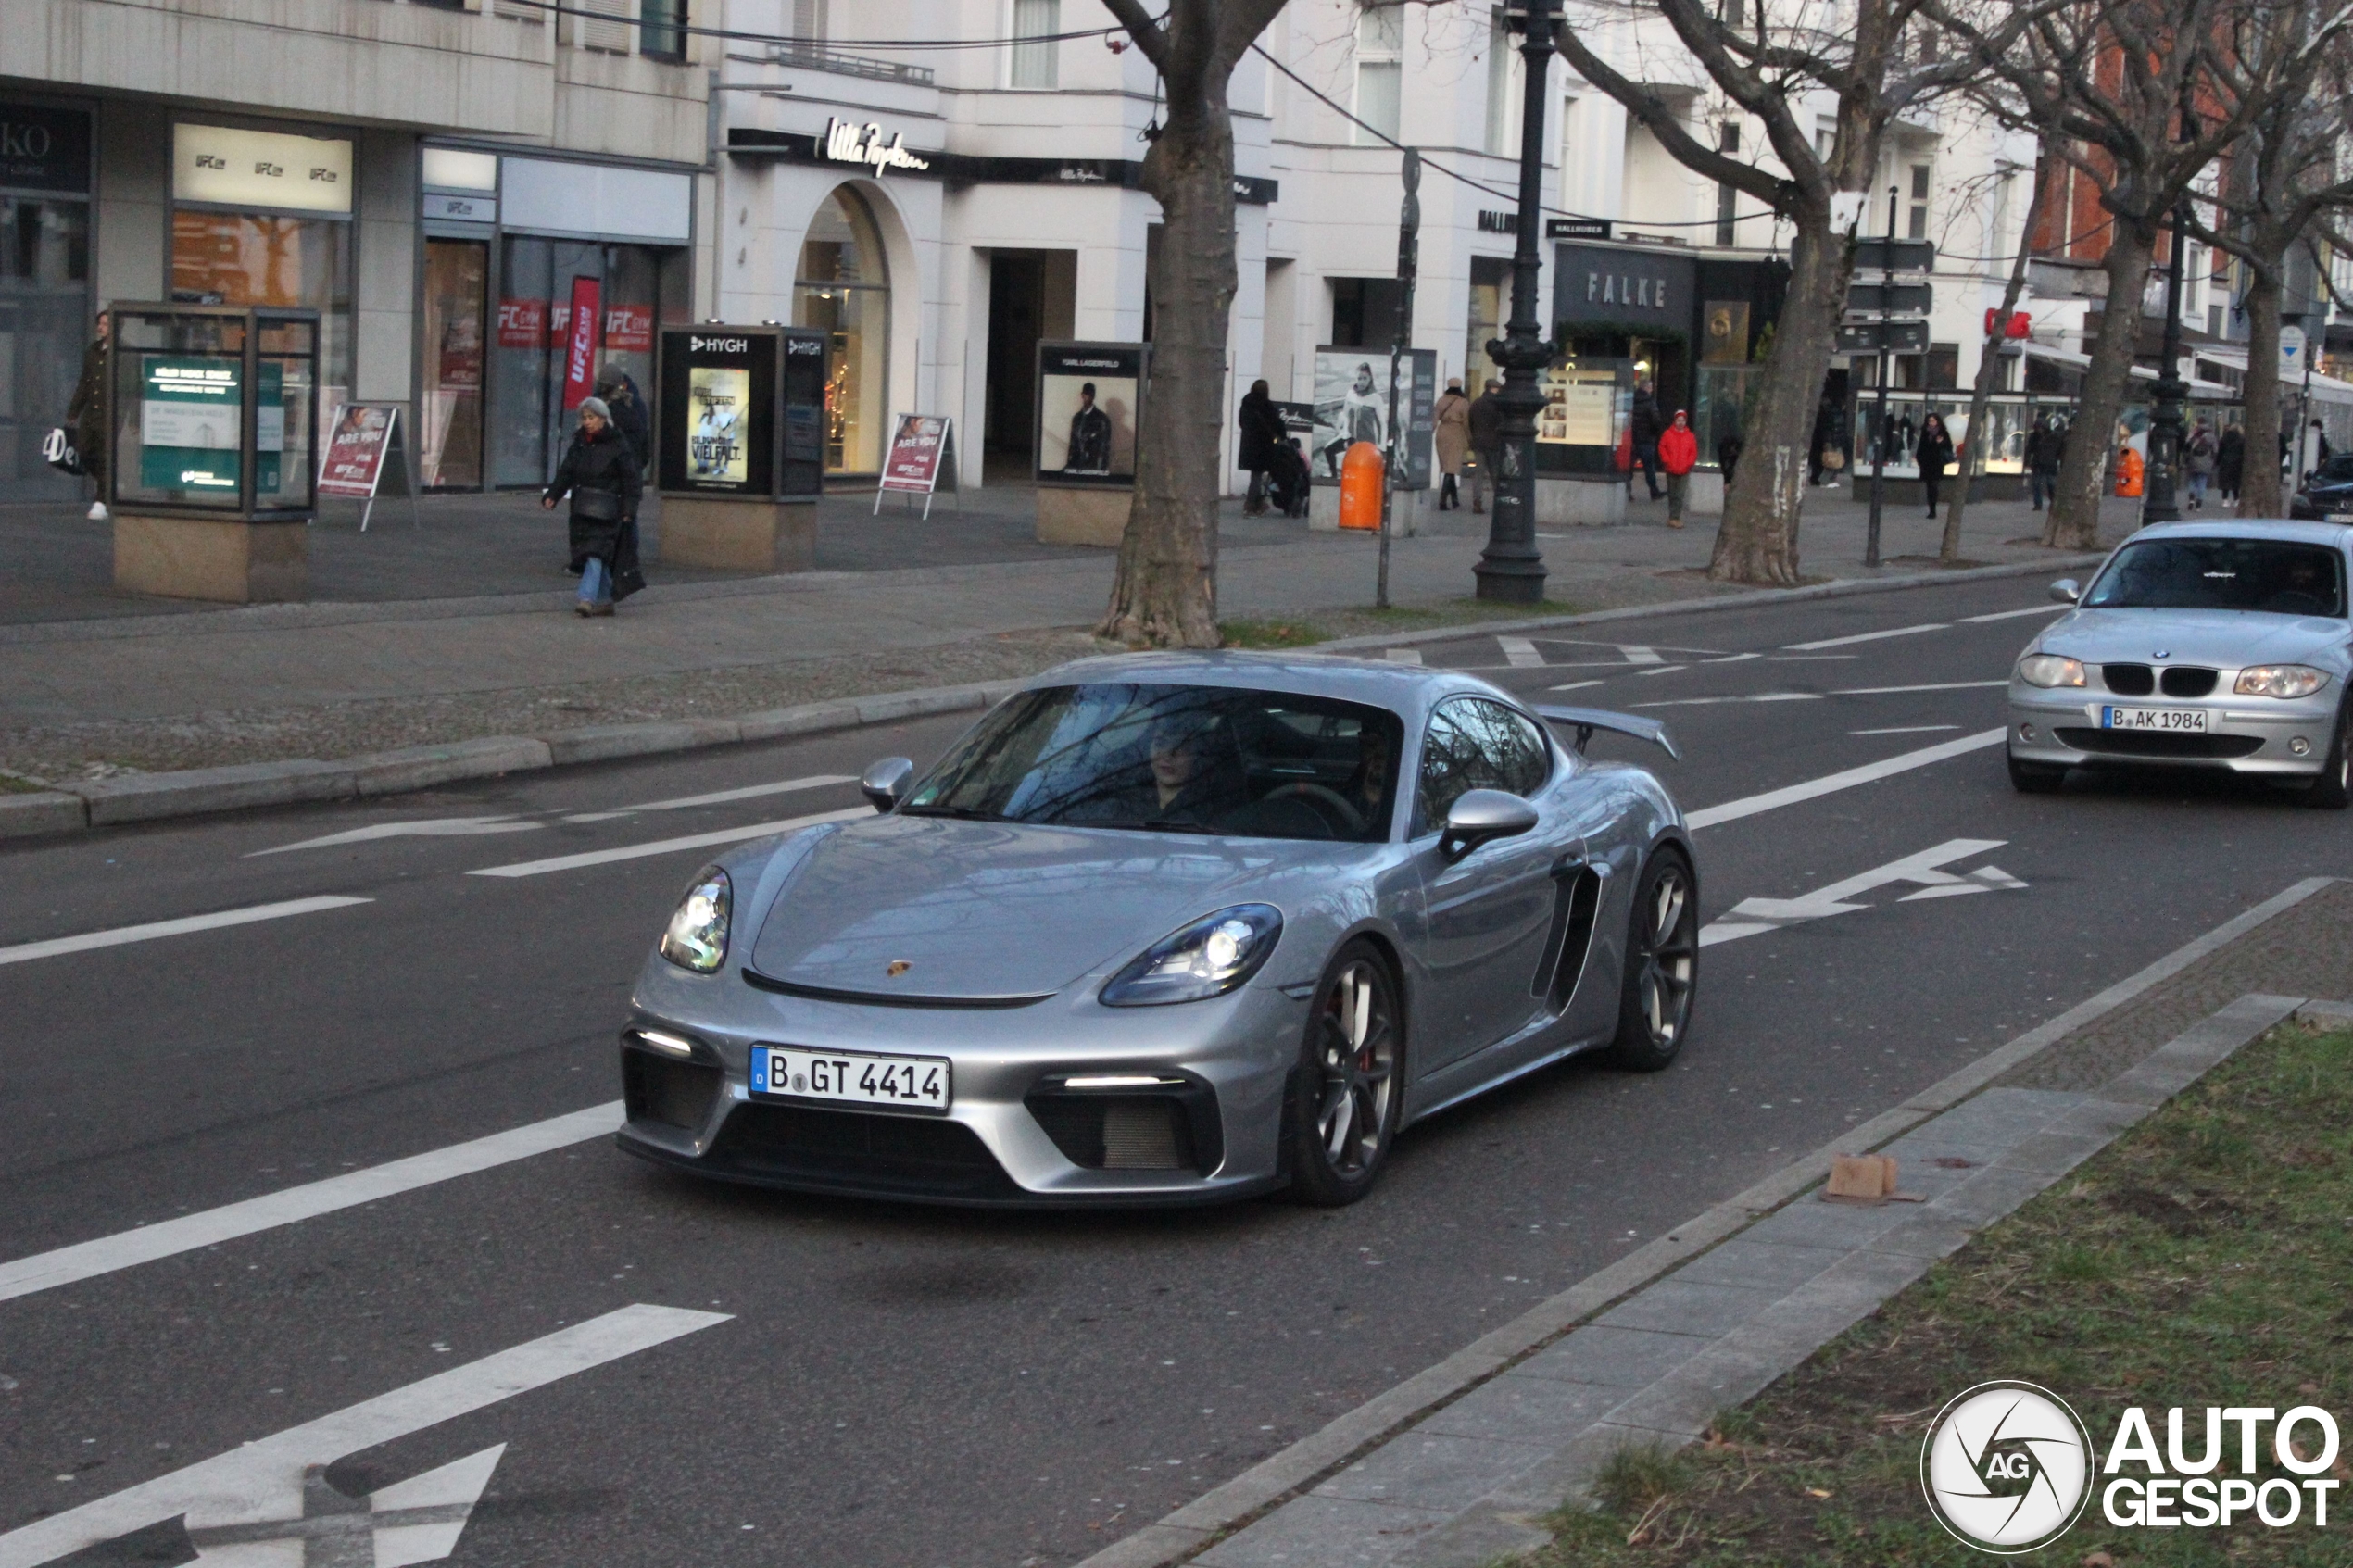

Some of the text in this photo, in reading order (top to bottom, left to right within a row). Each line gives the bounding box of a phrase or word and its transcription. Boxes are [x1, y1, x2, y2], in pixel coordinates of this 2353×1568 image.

[1588, 272, 1666, 307] FALKE
[571, 333, 586, 383] UFC
[706, 338, 748, 353] HYGH
[2113, 709, 2203, 730] B AK 1984
[771, 1055, 940, 1100] B GT 4414
